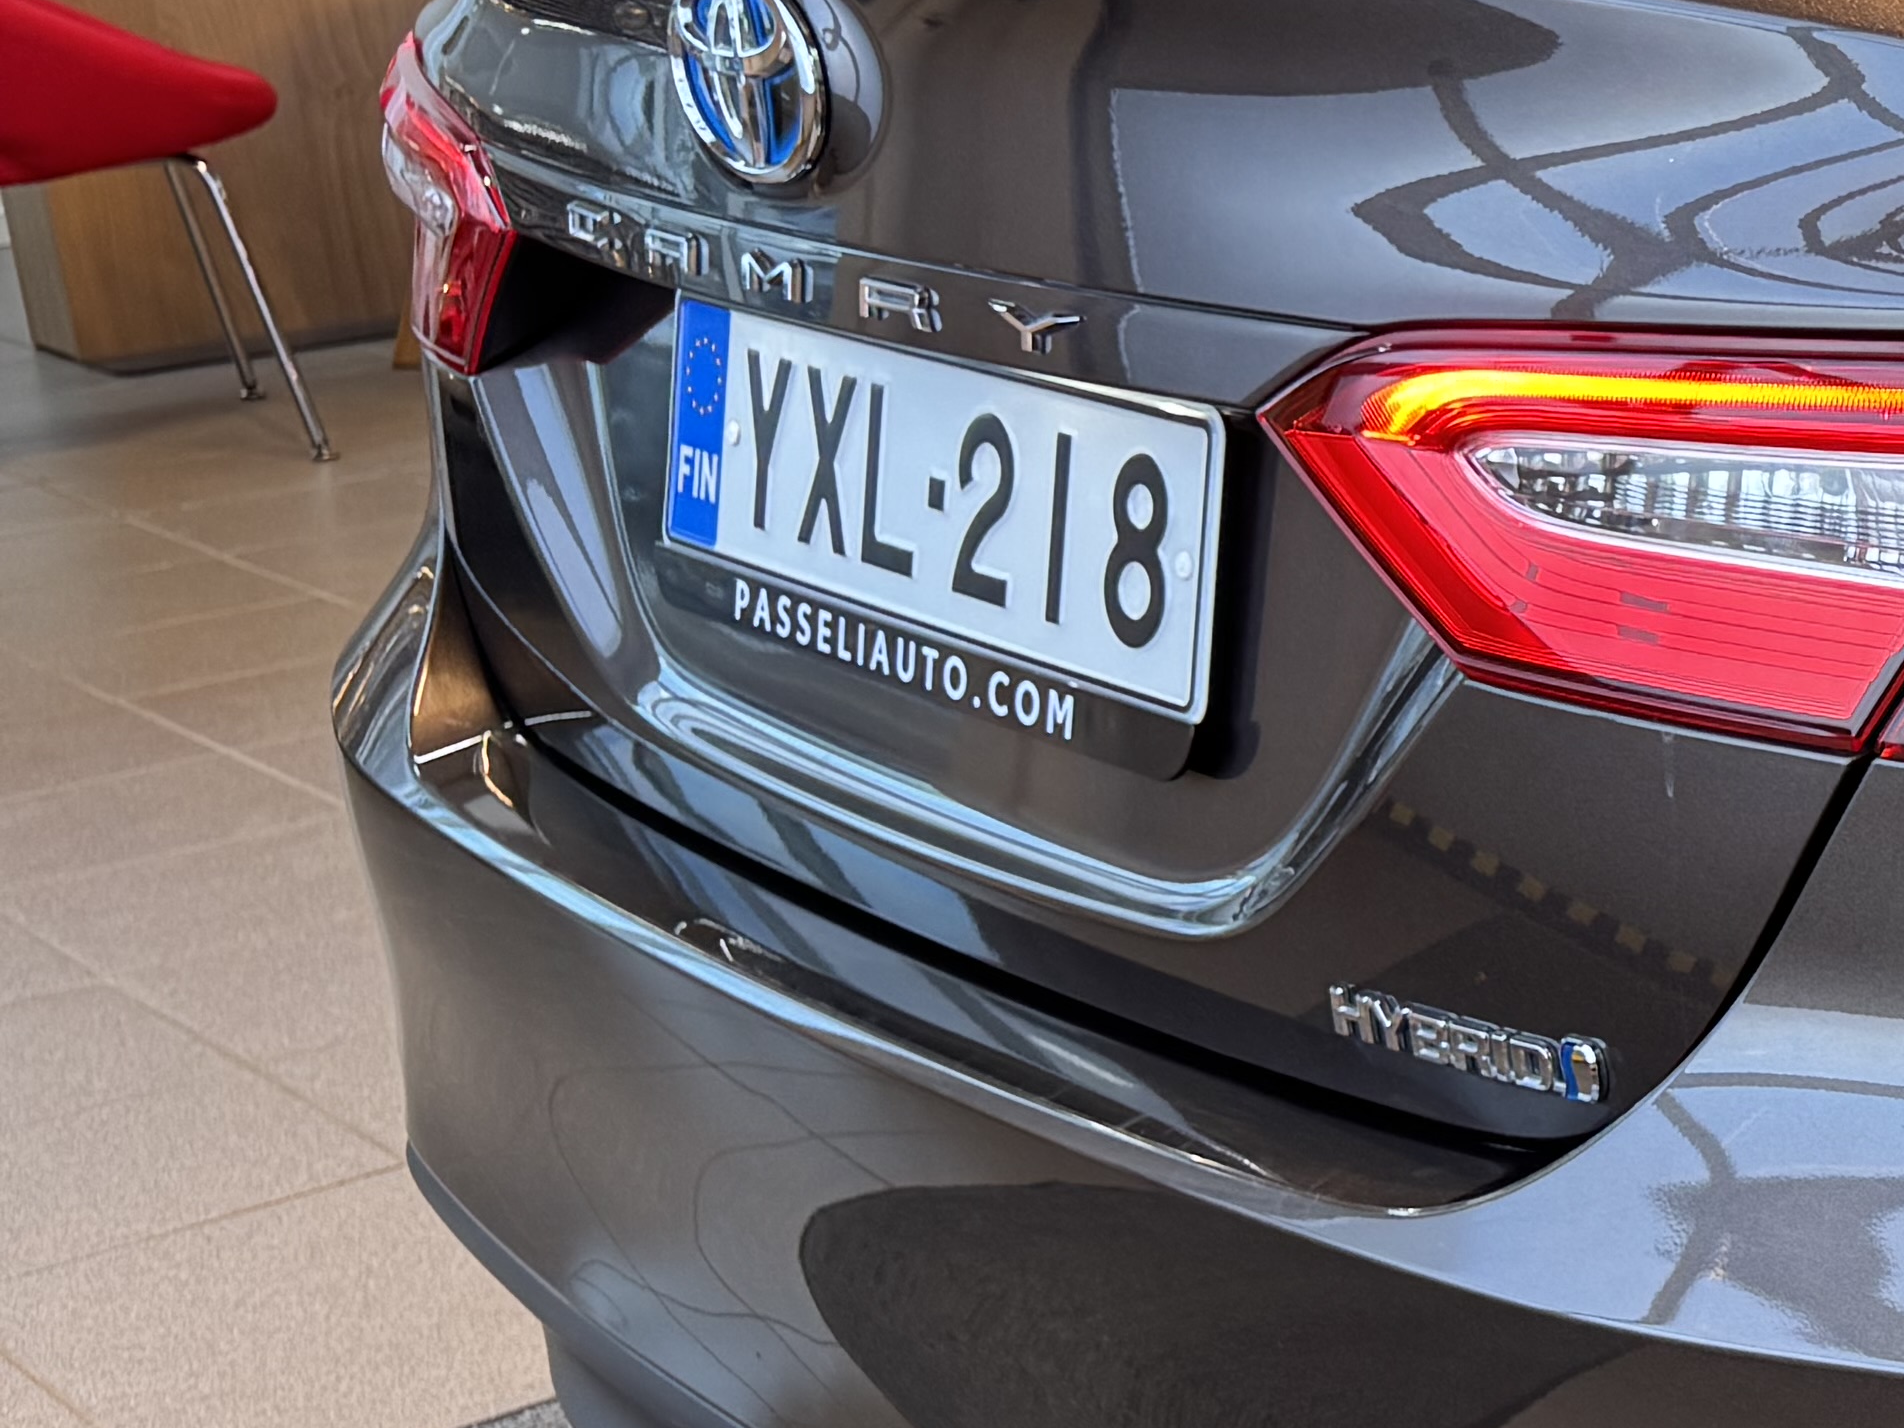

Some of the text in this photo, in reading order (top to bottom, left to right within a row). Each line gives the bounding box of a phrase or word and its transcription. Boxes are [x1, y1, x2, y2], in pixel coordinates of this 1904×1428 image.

[566, 199, 1087, 355] CAMRY
[676, 443, 720, 505] FIN
[747, 348, 1168, 649] YXL-218
[733, 578, 1076, 741] PASSELIAUTO.COM
[1329, 981, 1562, 1092] HYBRID
